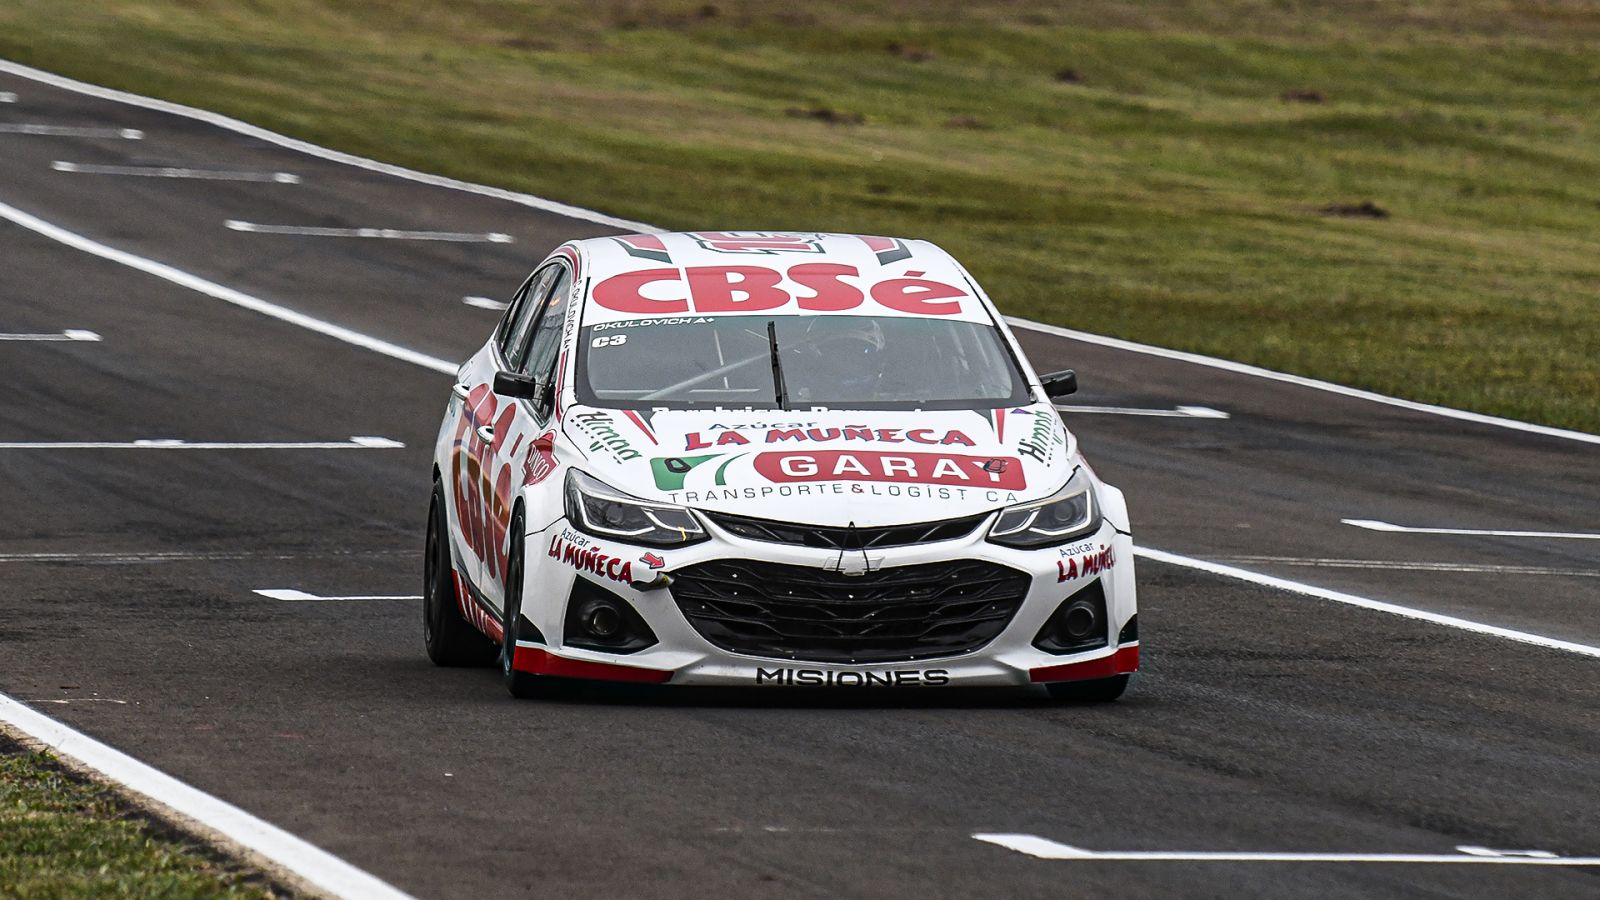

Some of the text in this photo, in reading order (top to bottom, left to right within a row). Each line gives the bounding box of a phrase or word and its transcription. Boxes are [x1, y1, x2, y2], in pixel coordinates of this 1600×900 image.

[592, 263, 969, 315] CBSé
[593, 317, 715, 331] OKULOVICH A+
[591, 334, 627, 348] C3
[708, 420, 818, 430] Azúcar
[685, 425, 976, 451] LA MUÑECA
[779, 455, 1008, 482] GARAY
[560, 528, 590, 547] Azúcar
[548, 534, 633, 584] LA MUÑECA
[1059, 542, 1095, 557] Azúcar
[1057, 558, 1079, 583] LA
[756, 667, 950, 687] MISIONES
